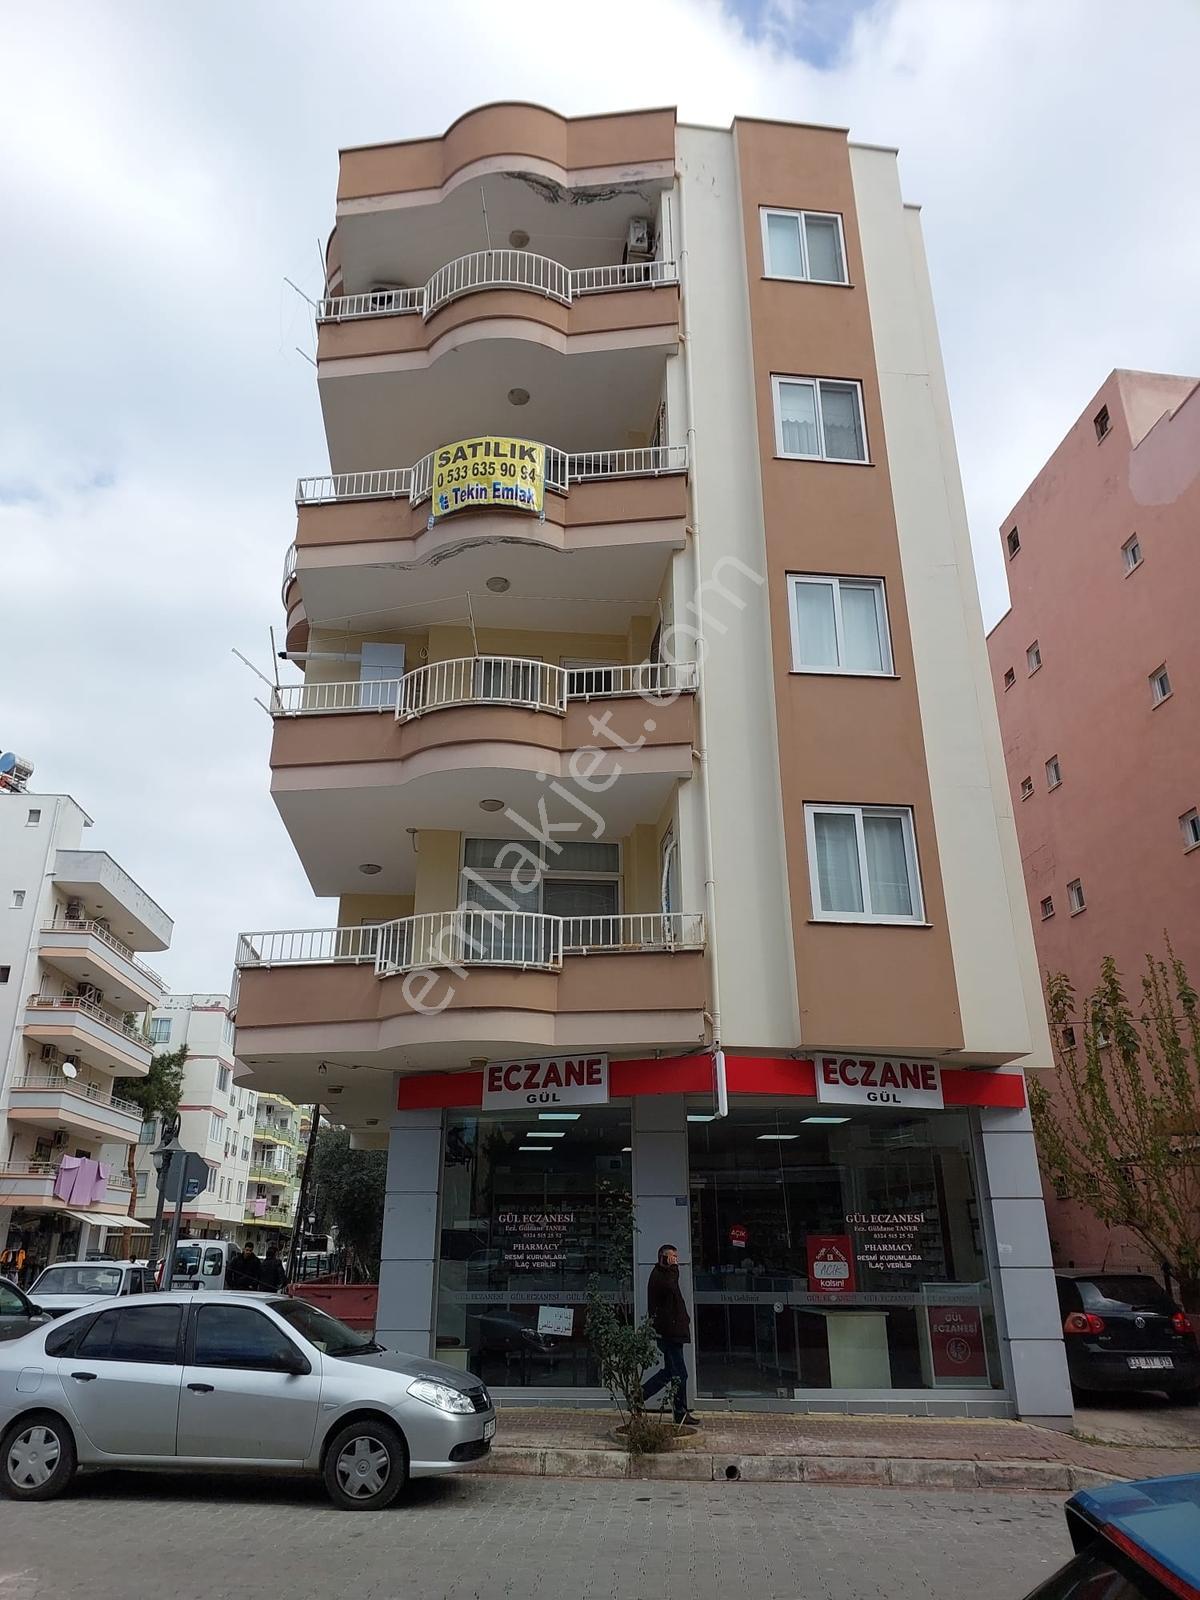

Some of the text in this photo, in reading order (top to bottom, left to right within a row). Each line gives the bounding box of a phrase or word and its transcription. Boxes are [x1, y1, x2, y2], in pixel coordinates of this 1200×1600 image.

[438, 441, 537, 468] SATILIK
[437, 461, 536, 488] 0 533 635 90 94
[452, 483, 488, 505] Tekin
[492, 481, 535, 505] Emlak
[488, 1059, 602, 1092] ECZANE
[822, 1057, 937, 1090] ECZANE
[527, 1091, 560, 1103] GÜL
[867, 1091, 901, 1103] GÜL
[498, 1212, 574, 1223] GÜL ECZANESİ
[845, 1212, 925, 1223] GÜL ECZANESİ
[513, 1243, 560, 1251] PHARMACY
[515, 1260, 556, 1269] İLAÇ VERİLİR
[868, 1261, 884, 1270] İLAÇ
[945, 1311, 964, 1322] GÜL
[933, 1322, 977, 1333] ECZANESİ
